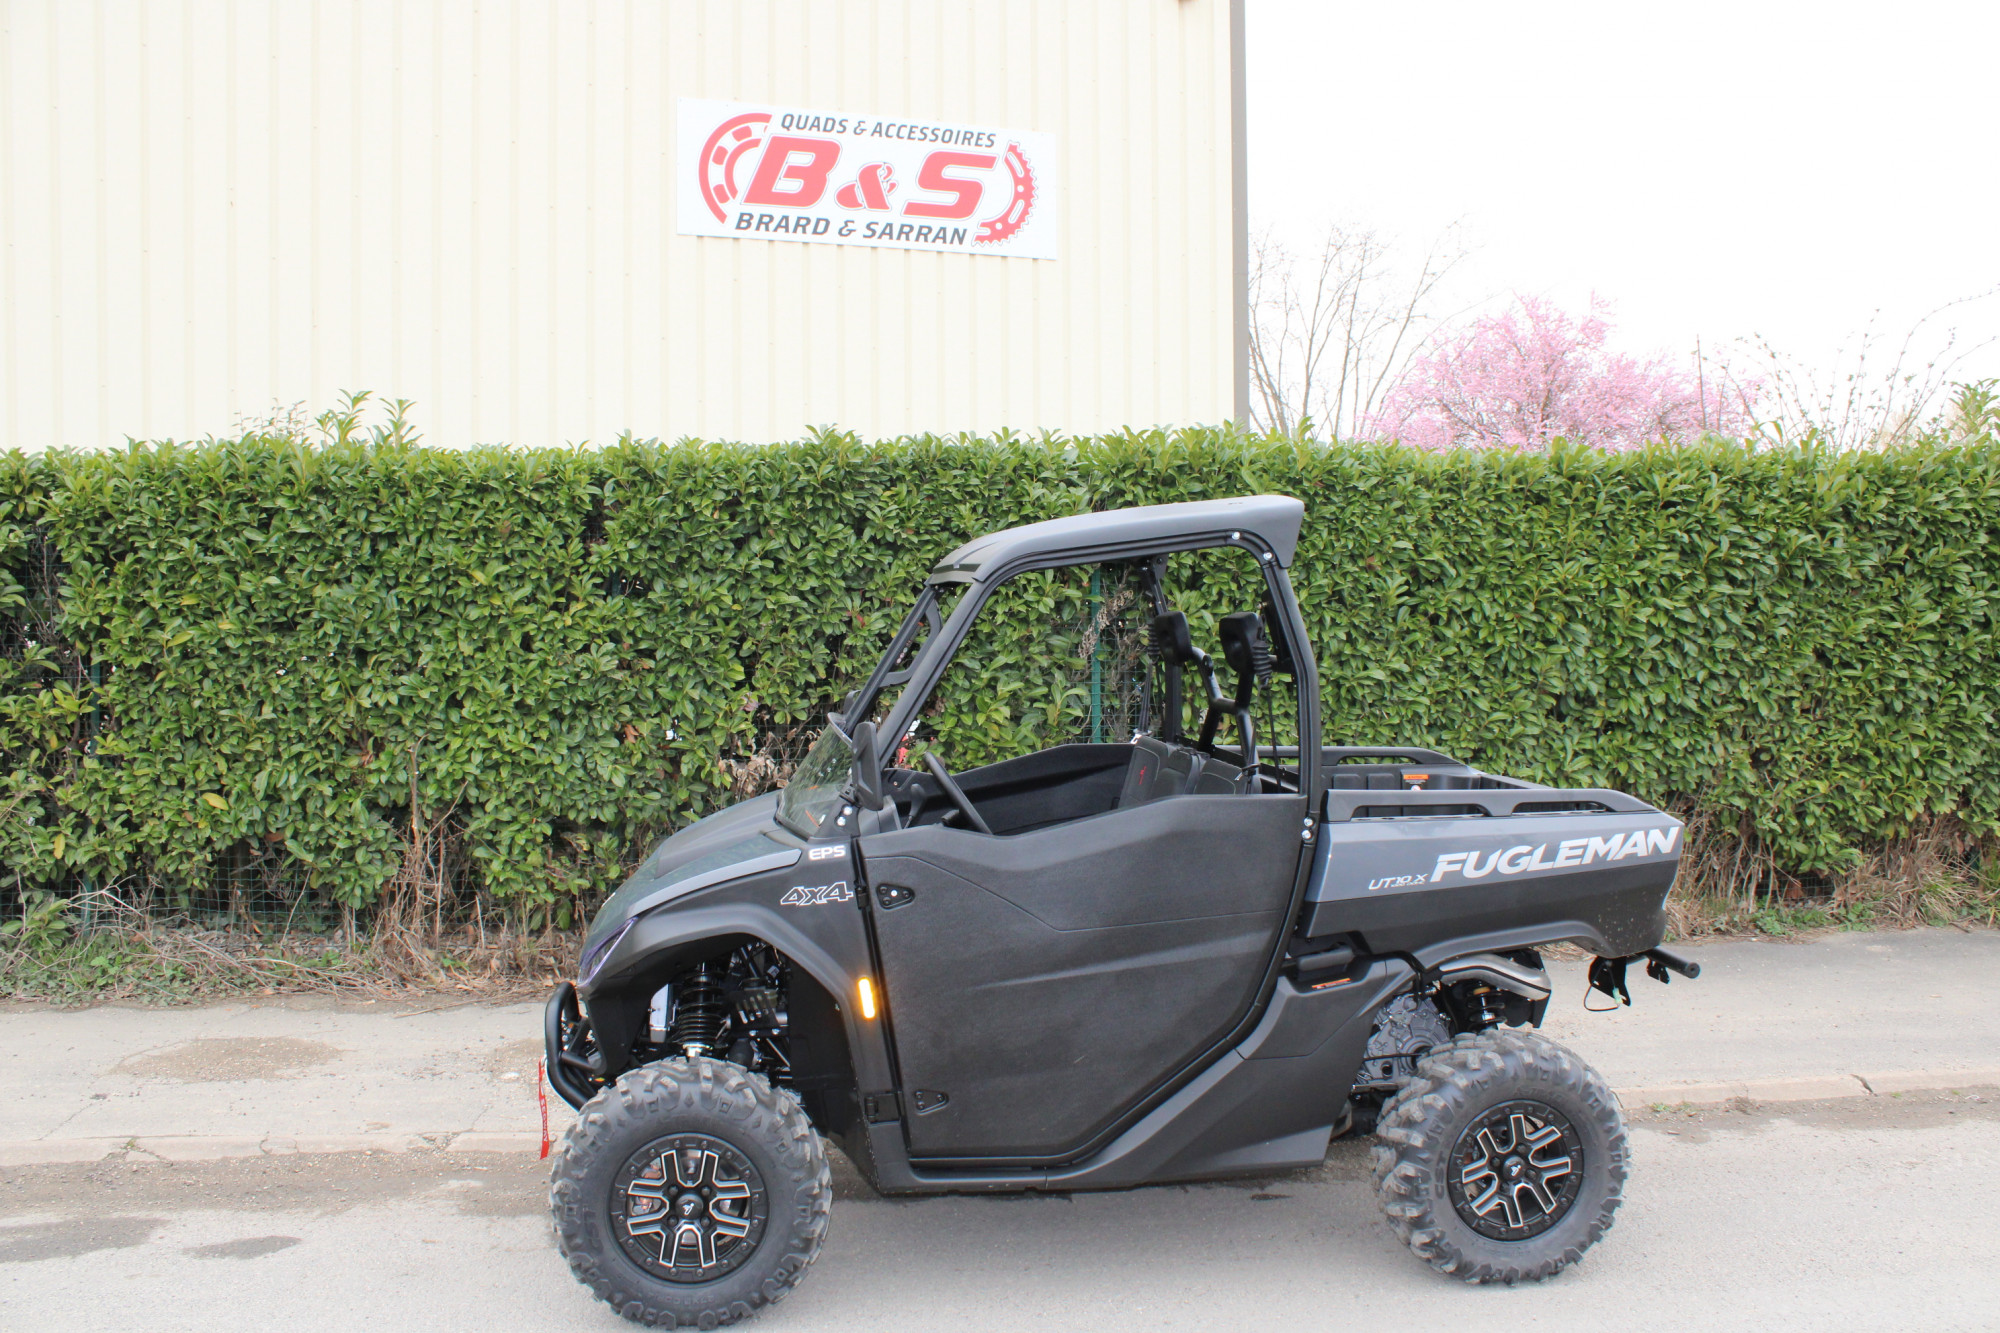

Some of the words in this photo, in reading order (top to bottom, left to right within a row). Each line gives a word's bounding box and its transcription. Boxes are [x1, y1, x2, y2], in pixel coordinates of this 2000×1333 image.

[780, 112, 848, 134] QUADS
[852, 120, 868, 135] &
[870, 121, 997, 149] ACCESSOIRES
[741, 134, 999, 220] B&S
[735, 212, 831, 236] BRARD
[837, 219, 857, 237] &
[862, 220, 968, 246] SARRAN
[808, 844, 847, 861] EPS
[1430, 826, 1681, 883] FUGLEMAN
